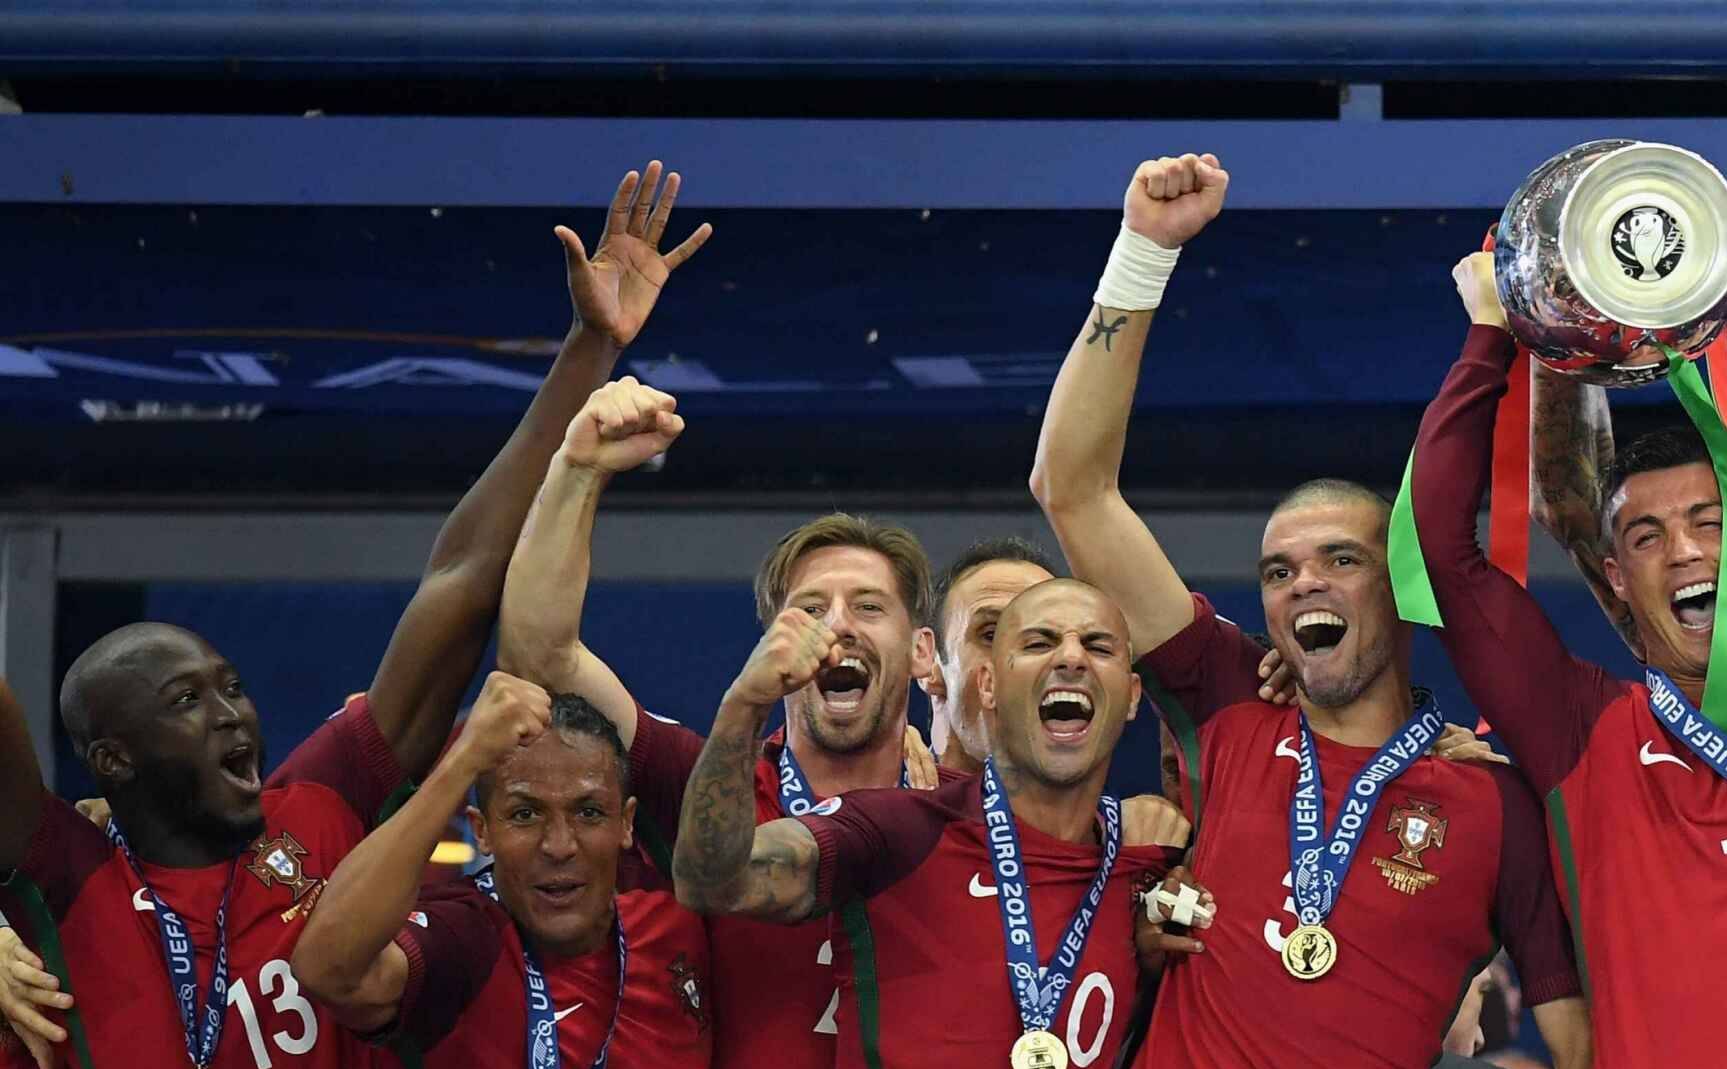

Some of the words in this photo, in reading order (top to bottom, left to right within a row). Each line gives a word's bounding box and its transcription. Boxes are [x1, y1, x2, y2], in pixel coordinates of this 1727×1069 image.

[1391, 712, 1442, 761] UEFA
[1354, 754, 1401, 798] EURO
[1295, 784, 1318, 842] UEFA
[1329, 798, 1369, 857] 2016
[986, 810, 1019, 878] EURO
[1002, 881, 1032, 946] 2016
[1058, 907, 1093, 968] UEFA
[1088, 841, 1118, 907] EURO
[162, 911, 192, 975] UEFA
